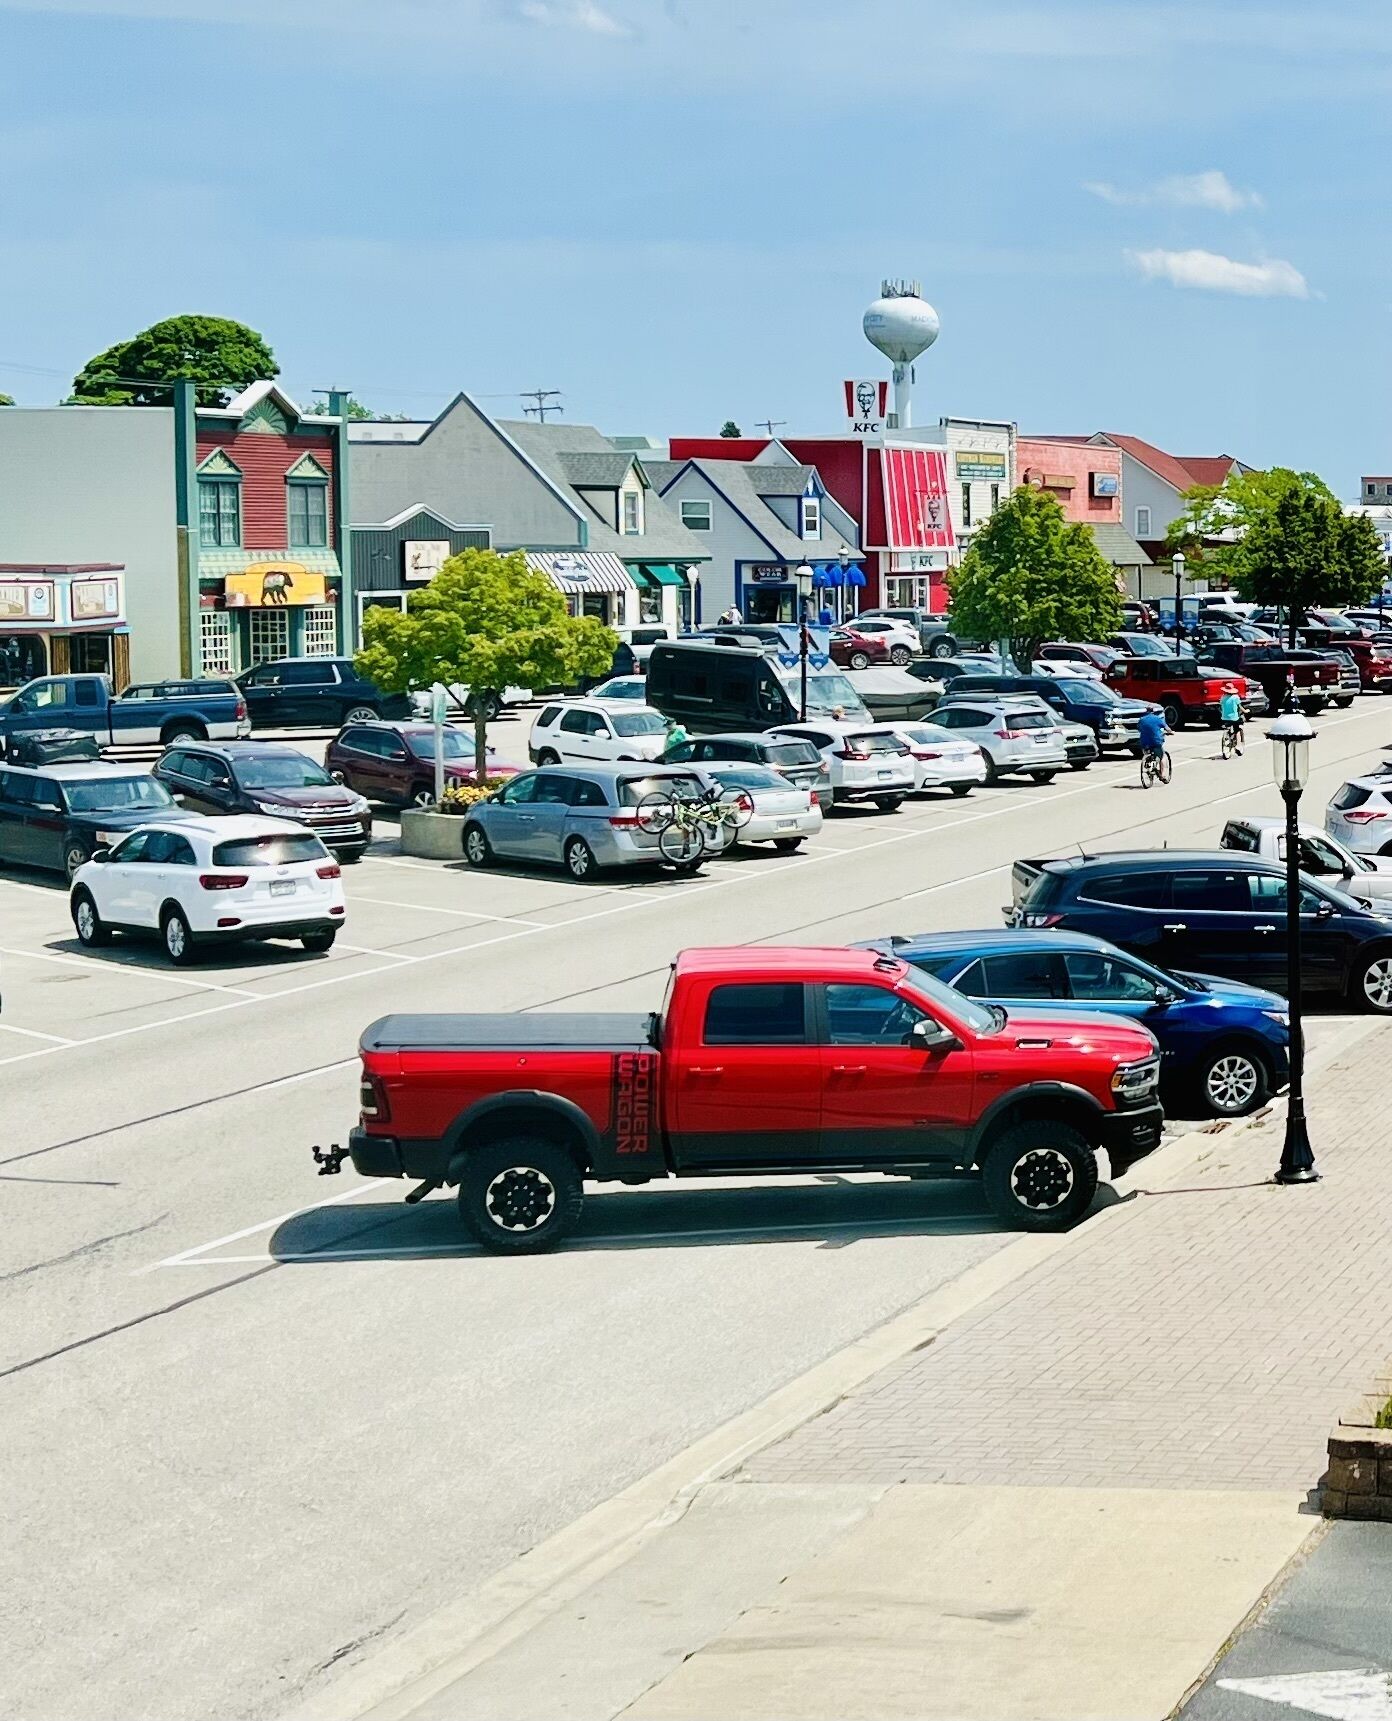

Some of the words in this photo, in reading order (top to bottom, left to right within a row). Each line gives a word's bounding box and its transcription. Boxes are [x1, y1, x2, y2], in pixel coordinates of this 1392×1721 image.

[853, 423, 879, 432] KFC
[919, 555, 934, 567] KFC
[616, 1053, 633, 1153] WAGON
[632, 1053, 649, 1153] POWER
